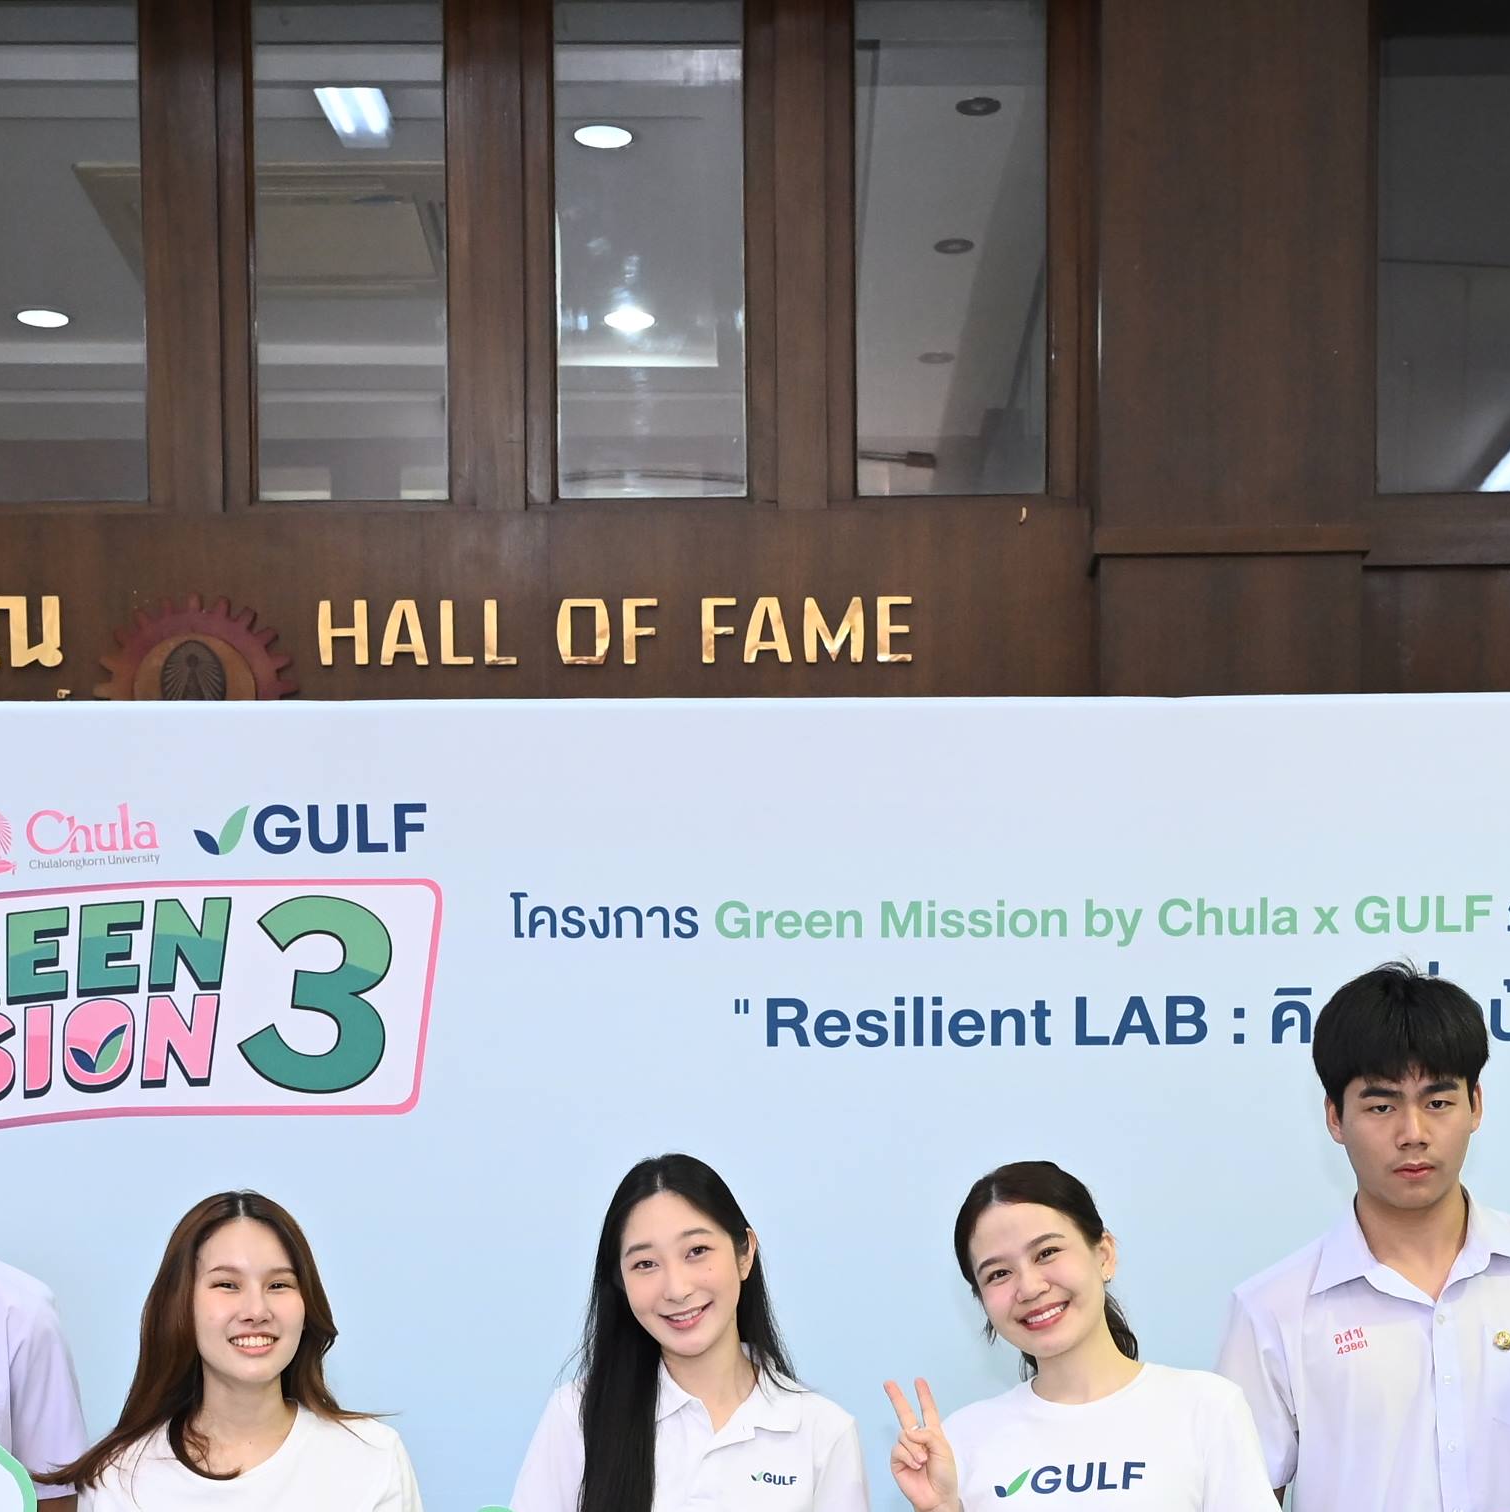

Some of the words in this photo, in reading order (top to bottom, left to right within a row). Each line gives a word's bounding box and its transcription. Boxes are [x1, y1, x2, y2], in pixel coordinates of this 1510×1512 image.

[317, 599, 517, 666] HALL
[556, 598, 658, 665] OF
[701, 596, 913, 664] FAME
[26, 802, 159, 855] Chula
[253, 803, 427, 855] GULF
[29, 857, 106, 870] Chulalongkorn
[107, 853, 161, 865] University
[510, 892, 700, 939] โครงการ
[714, 900, 863, 940] Green
[881, 898, 1069, 938] Mission
[1084, 898, 1143, 946] by
[1157, 897, 1299, 937] Chula
[1314, 904, 1340, 935] x
[1354, 894, 1494, 934] GULF
[238, 895, 393, 1094] 3
[765, 996, 1053, 1048] Resilient
[1075, 995, 1209, 1047] LAB
[763, 1472, 797, 1486] GULF
[1031, 1461, 1146, 1494] GULF
